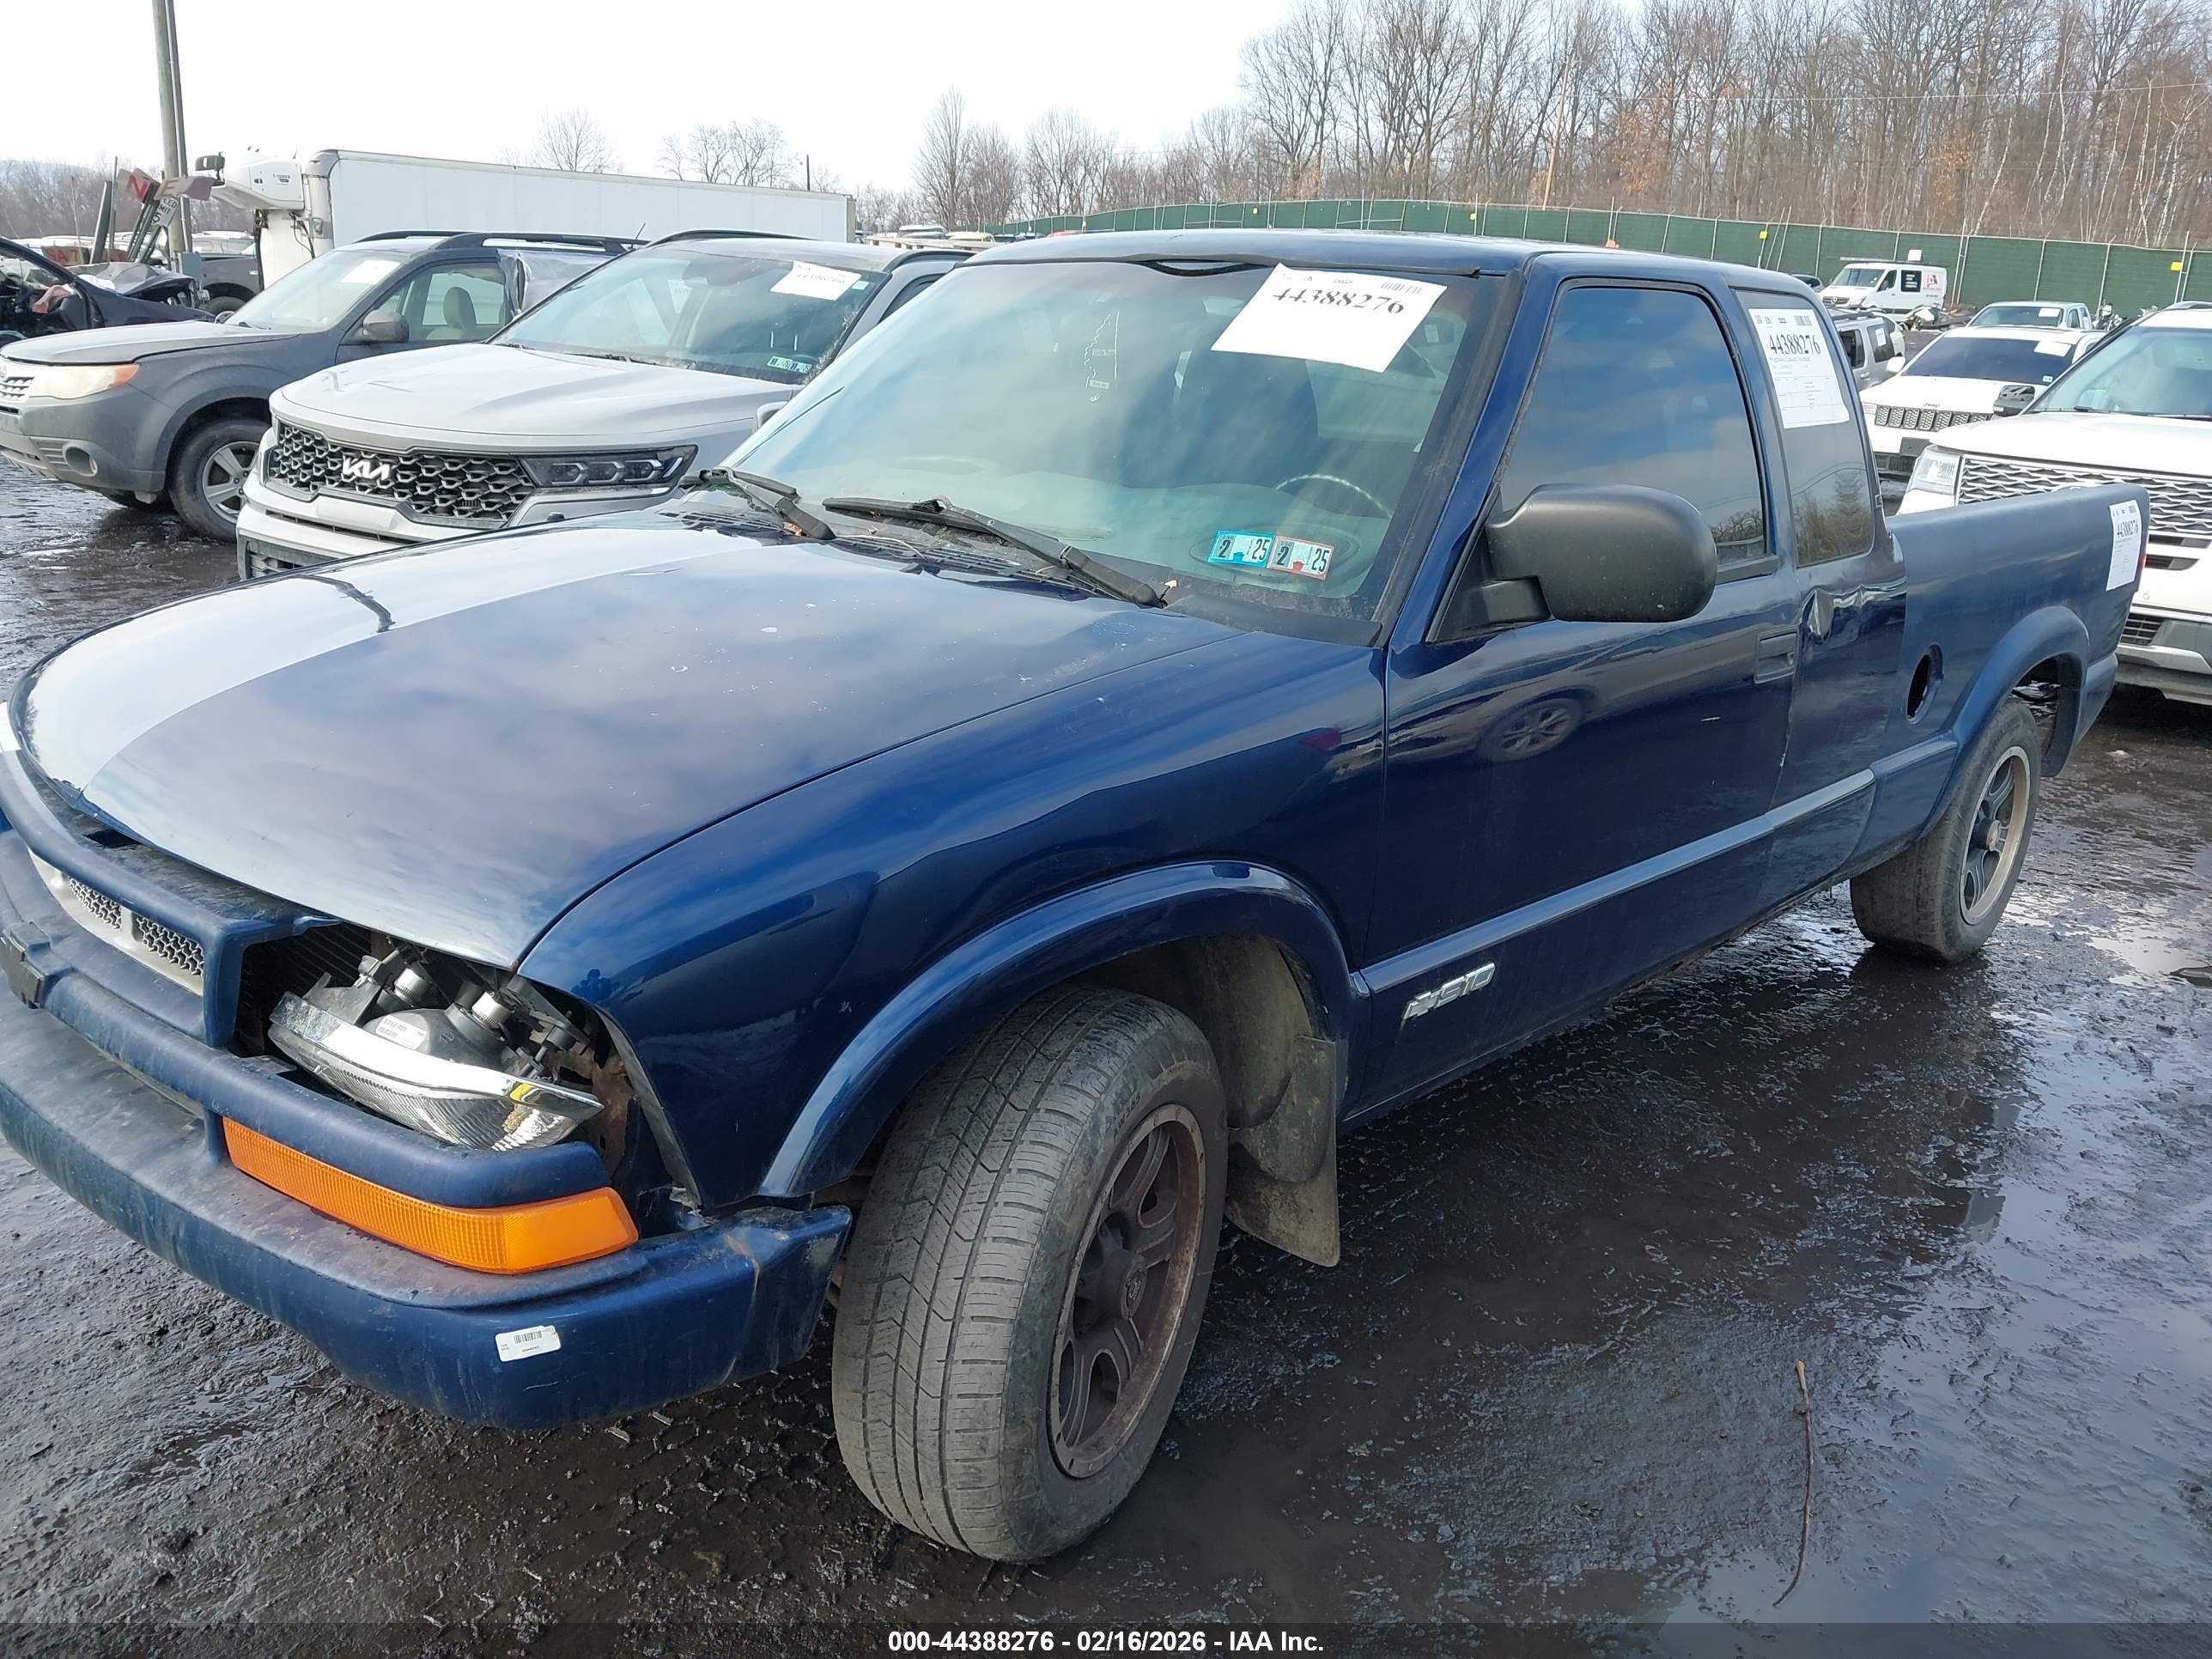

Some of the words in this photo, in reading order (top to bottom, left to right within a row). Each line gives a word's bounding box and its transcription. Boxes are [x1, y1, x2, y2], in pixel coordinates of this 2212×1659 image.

[1273, 287, 1405, 315] 44388276
[1769, 334, 1820, 355] 44388276
[343, 458, 391, 480] KIA
[1218, 539, 1231, 558] 2
[1252, 538, 1270, 561] 25
[1277, 546, 1289, 566] 2
[1311, 548, 1329, 572] 25
